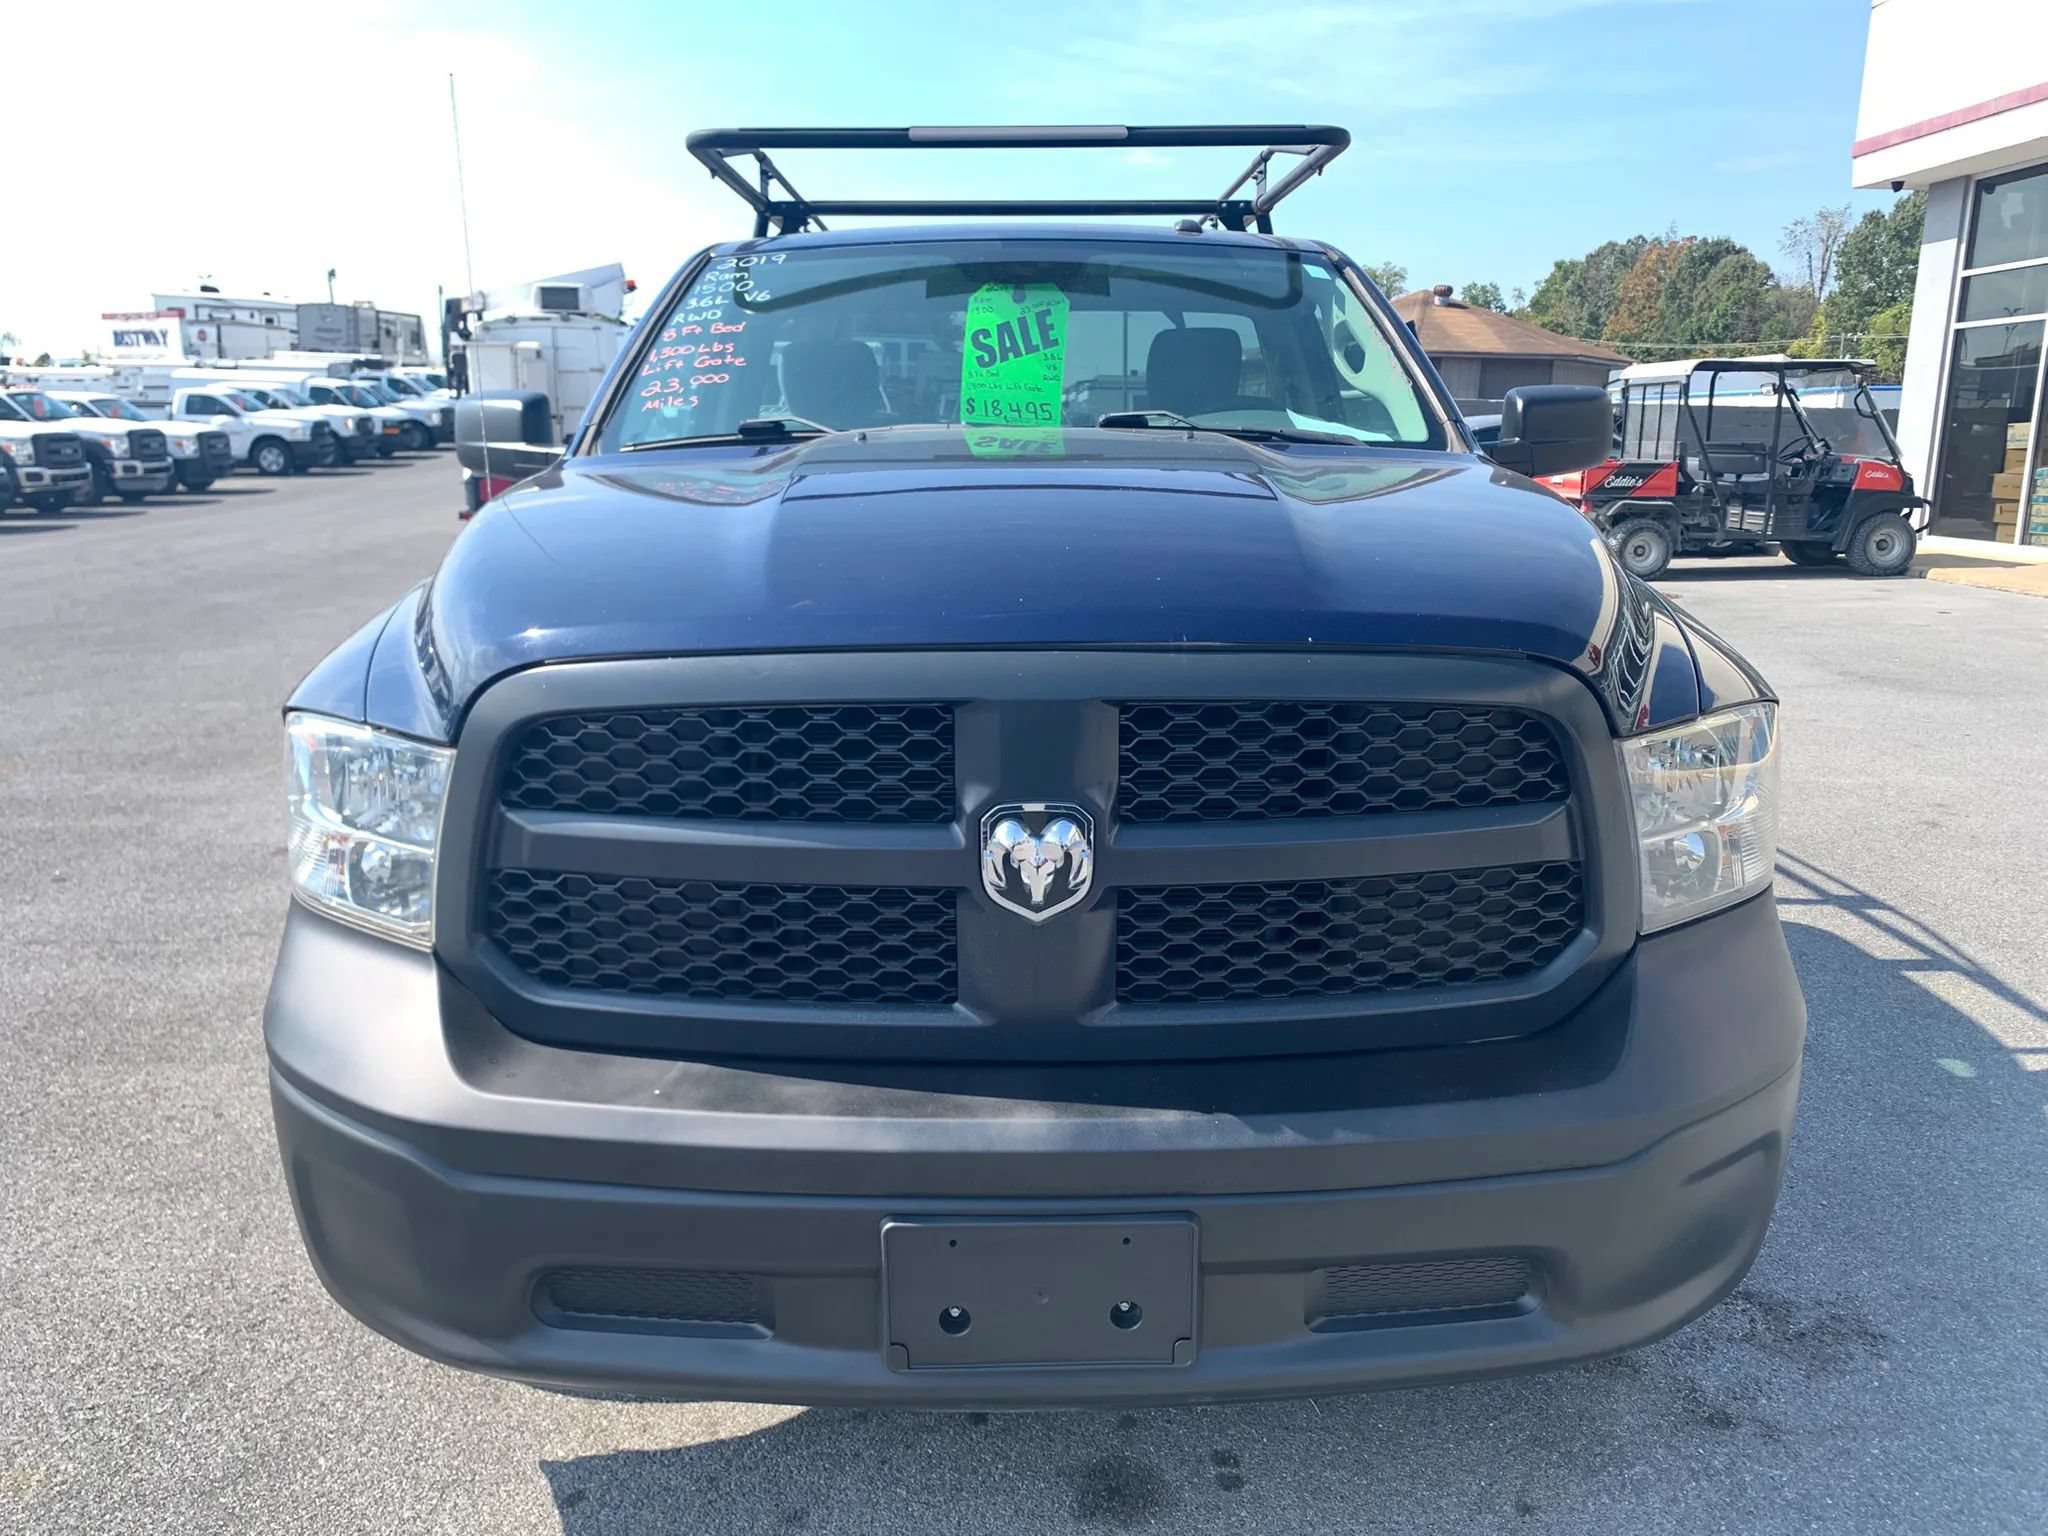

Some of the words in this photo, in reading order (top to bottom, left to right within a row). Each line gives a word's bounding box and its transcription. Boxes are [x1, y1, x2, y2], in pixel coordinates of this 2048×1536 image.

[716, 254, 787, 270] 2019
[704, 271, 749, 282] Ram
[694, 280, 754, 295] 1500
[744, 290, 771, 302] V6
[671, 309, 722, 326] RWD
[710, 321, 746, 334] Bed
[971, 308, 1060, 369] SALE
[697, 342, 735, 353] Lbs
[693, 355, 747, 367] Gate
[641, 374, 729, 397] 23,000
[641, 396, 699, 412] Miles
[1604, 475, 1644, 488] Eddie's
